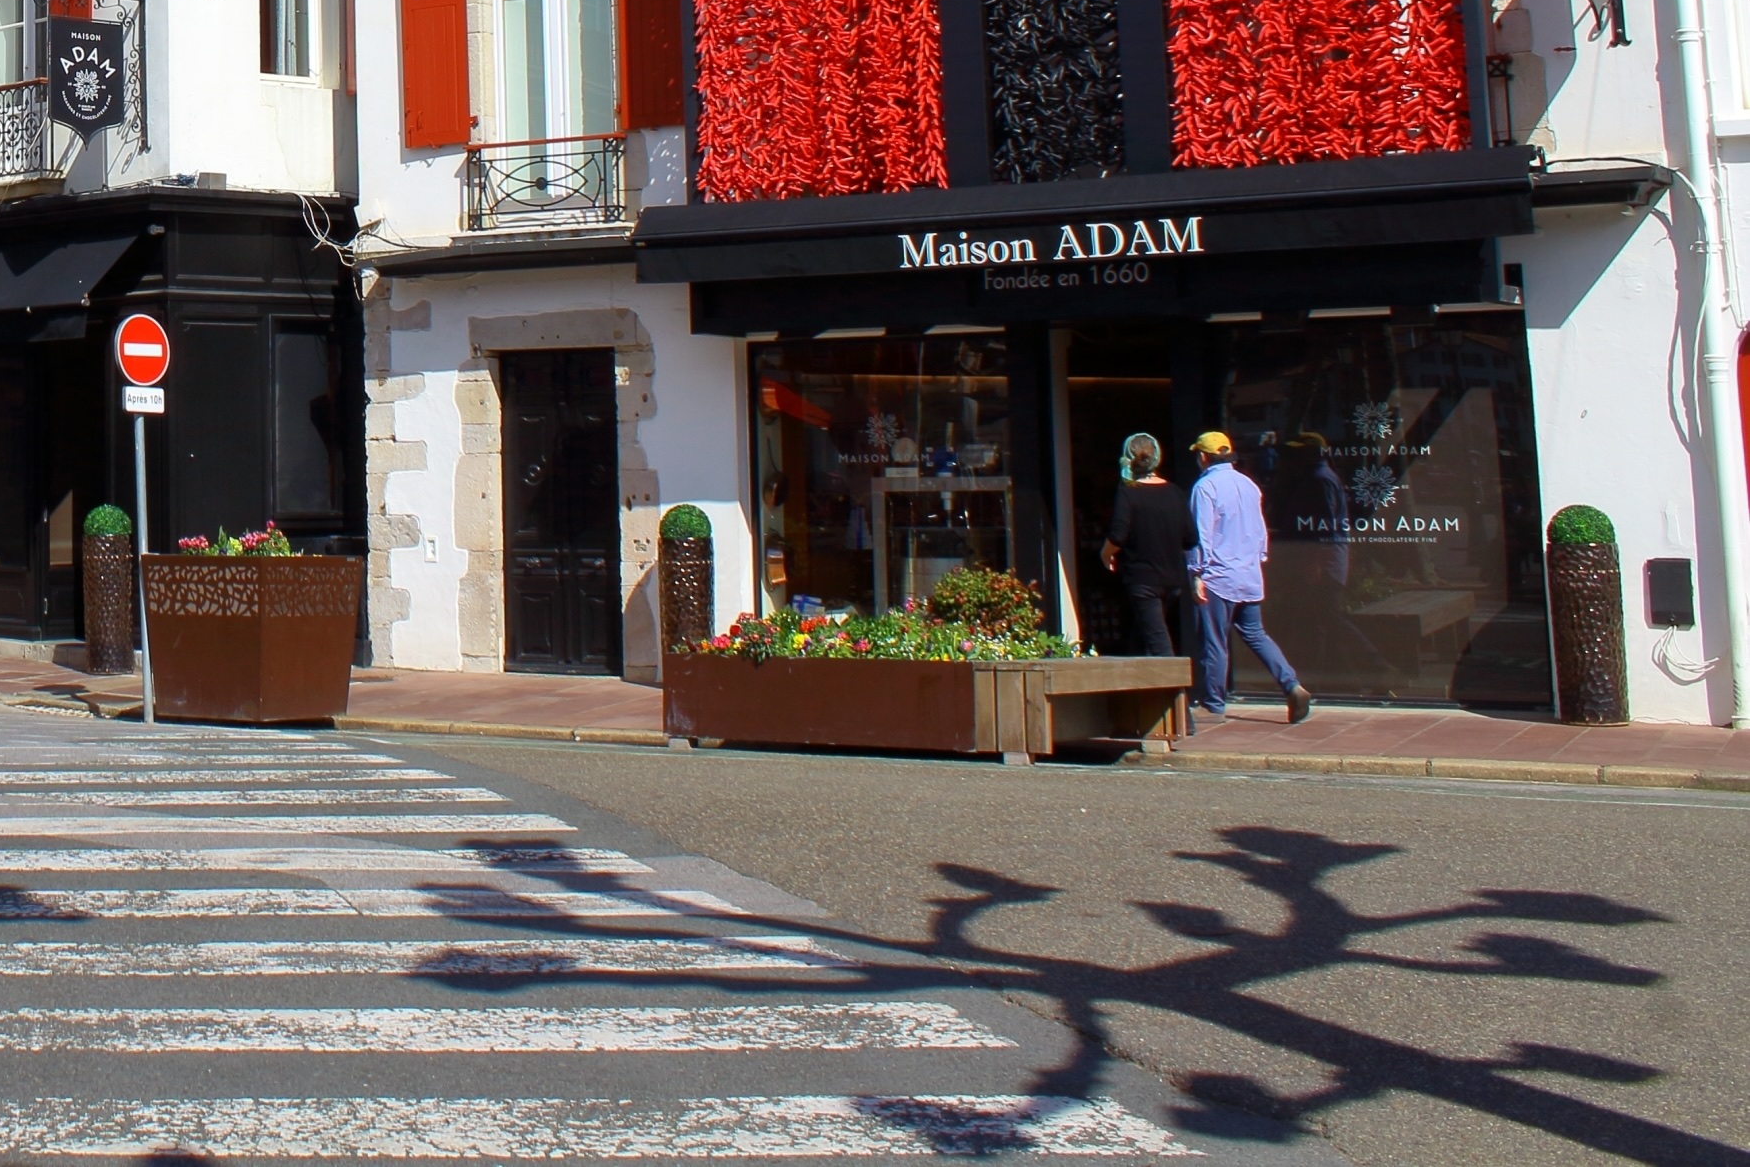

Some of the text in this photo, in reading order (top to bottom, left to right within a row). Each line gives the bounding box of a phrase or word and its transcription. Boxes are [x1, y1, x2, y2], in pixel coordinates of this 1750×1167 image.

[71, 32, 101, 41] MAISON
[59, 46, 116, 79] ADAM
[898, 216, 1205, 268] Maison ADAM
[984, 262, 1149, 290] Fondée en 1660
[127, 393, 163, 406] Après 10h
[1320, 444, 1432, 457] MAISON ADAM
[838, 453, 889, 464] MAISON
[1297, 515, 1460, 532] MAISON ADAM
